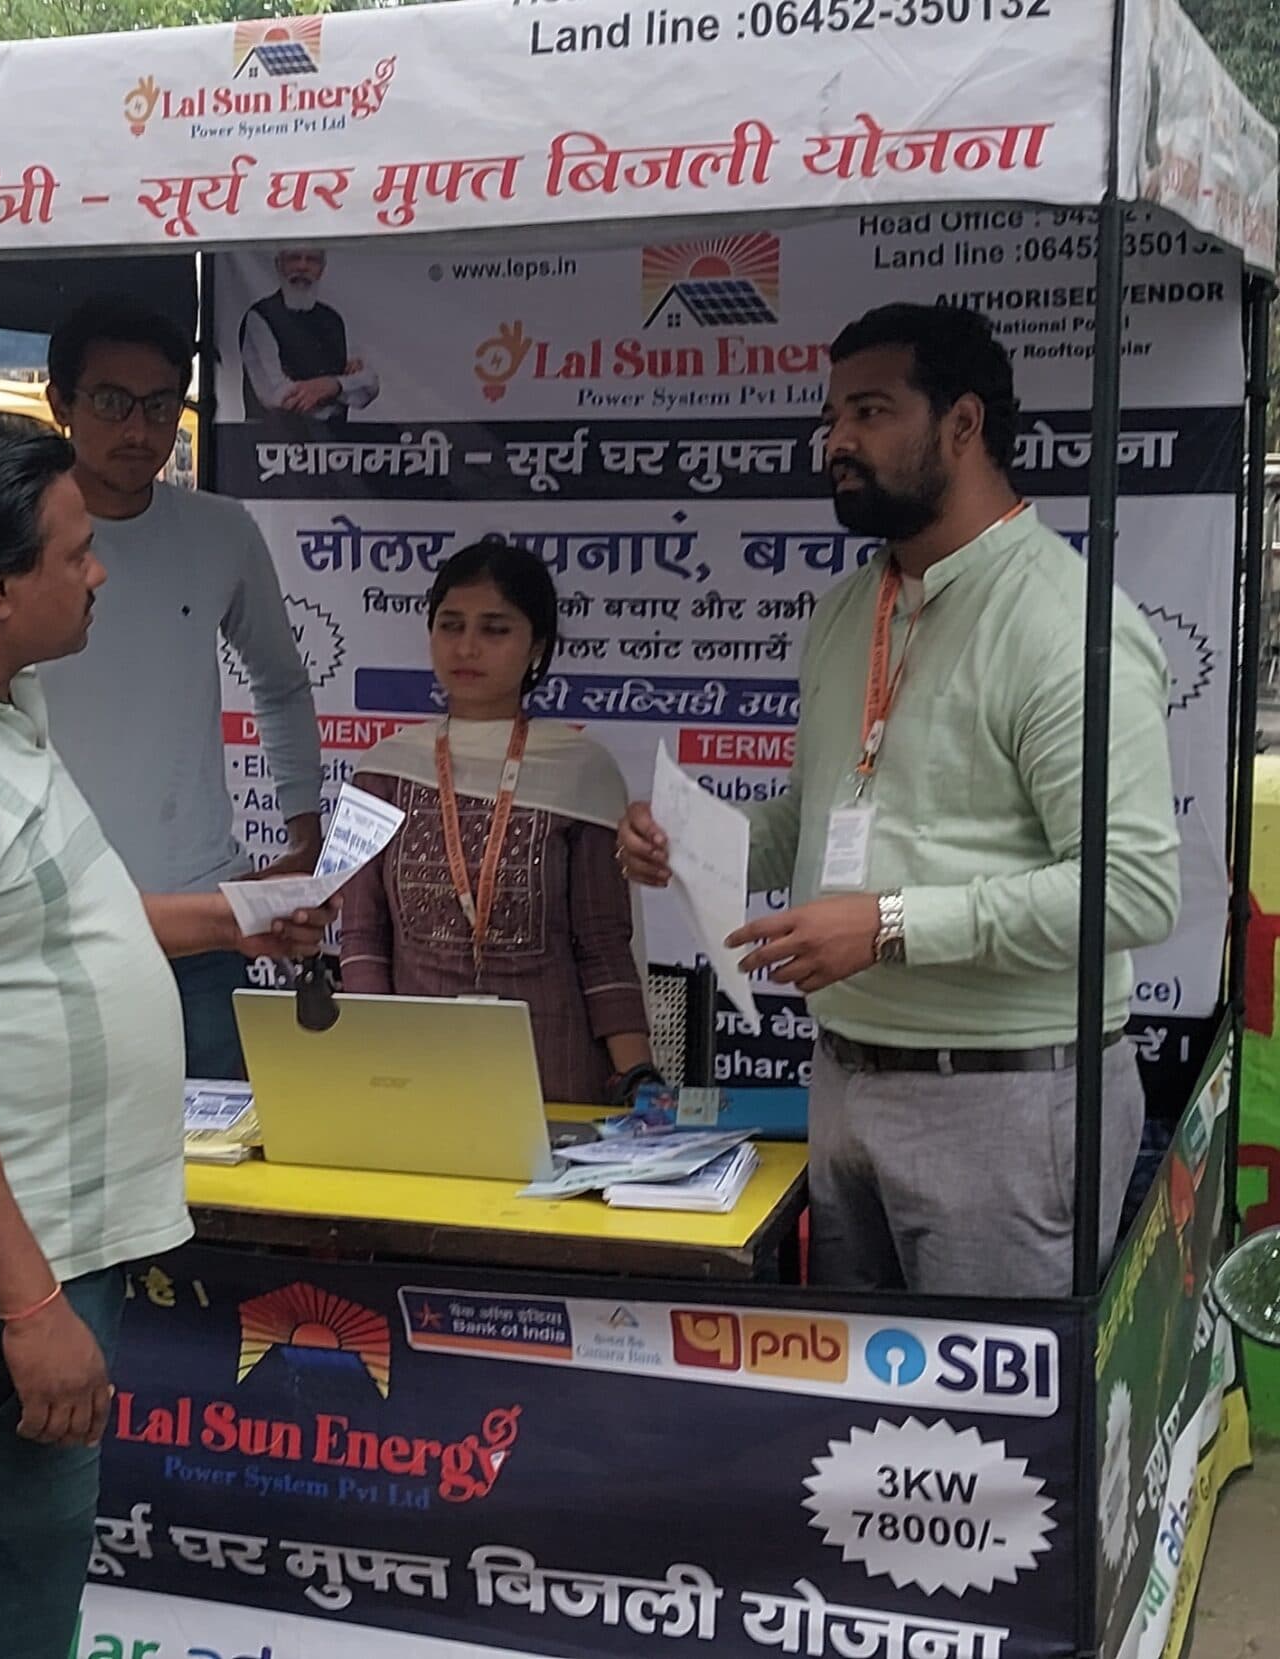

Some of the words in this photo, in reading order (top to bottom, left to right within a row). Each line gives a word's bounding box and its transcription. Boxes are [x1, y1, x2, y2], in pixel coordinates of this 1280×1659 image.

[531, 15, 630, 55] Land
[646, 9, 720, 47] line
[163, 87, 205, 121] Lal
[211, 83, 271, 118] Sun
[278, 54, 397, 122] Energy
[190, 122, 233, 140] Power
[237, 119, 288, 140] System
[291, 117, 318, 135] Pvt
[321, 115, 347, 133] Ltd
[140, 154, 257, 237] सूर्य
[264, 166, 355, 215] घर
[370, 155, 524, 227] मुफ्त
[547, 121, 780, 198] बिजली
[803, 113, 1055, 179] योजना
[452, 258, 577, 282] www.leps.in
[874, 244, 944, 269] Land
[954, 241, 1005, 266] line
[533, 339, 601, 381] Lal
[614, 338, 704, 379] Sun
[577, 387, 645, 408] Power
[651, 387, 730, 412] System
[739, 385, 777, 406] Pvt
[785, 383, 825, 405] Ltd
[256, 430, 453, 484] प्रधानमंत्री
[505, 427, 591, 493] सूर्य
[599, 438, 670, 476] घर
[676, 438, 797, 493] मुफ्त
[296, 514, 456, 573] सोलर
[691, 589, 747, 621] और
[697, 733, 798, 762] TERMS
[452, 1319, 499, 1338] Bank
[500, 1322, 520, 1338] of
[522, 1325, 567, 1344] India
[750, 1320, 843, 1370] pnb
[935, 1333, 1052, 1401] SBI
[115, 1391, 191, 1446] Lal
[200, 1400, 303, 1463] Sun
[313, 1402, 523, 1504] Energy
[163, 1455, 237, 1487] Power
[243, 1465, 330, 1499] System
[338, 1475, 380, 1504] Pvt
[388, 1481, 432, 1512] Ltd
[874, 1464, 980, 1506] 3KW
[849, 1509, 1008, 1555] 78000/-
[169, 1521, 271, 1576] घर
[278, 1538, 452, 1612] मुफ्त
[467, 1543, 724, 1642] बिजली
